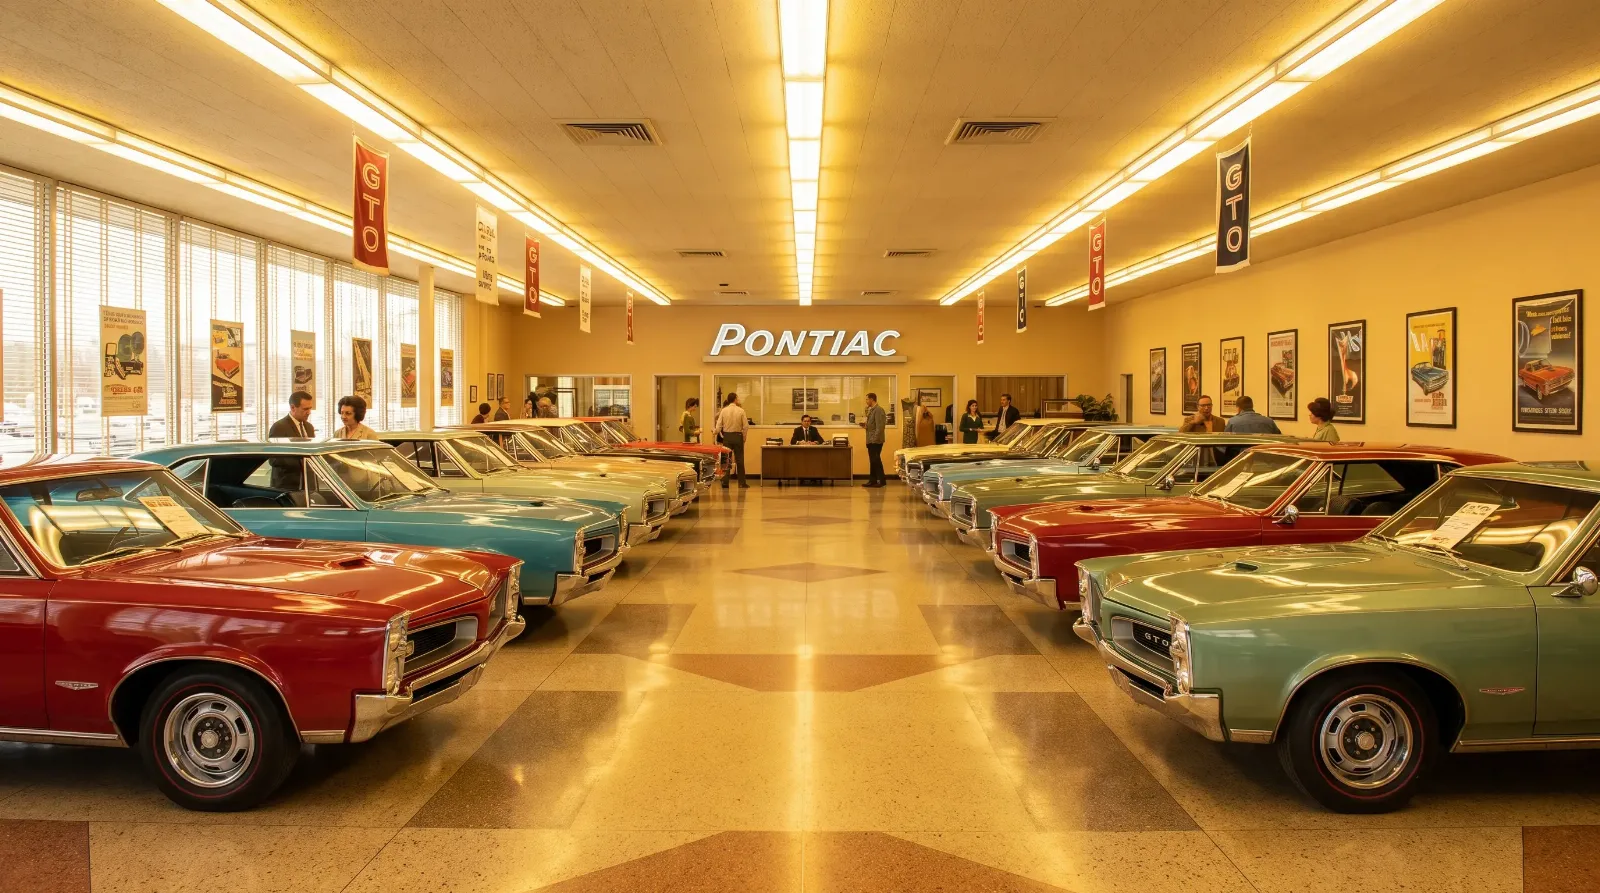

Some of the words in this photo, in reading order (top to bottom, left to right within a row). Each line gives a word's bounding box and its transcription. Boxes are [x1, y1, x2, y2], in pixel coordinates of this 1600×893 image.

[362, 162, 380, 253] GTO
[1226, 163, 1243, 253] GTO
[527, 246, 538, 304] GTO
[1091, 234, 1102, 295] GTO
[1145, 632, 1168, 646] GTO
